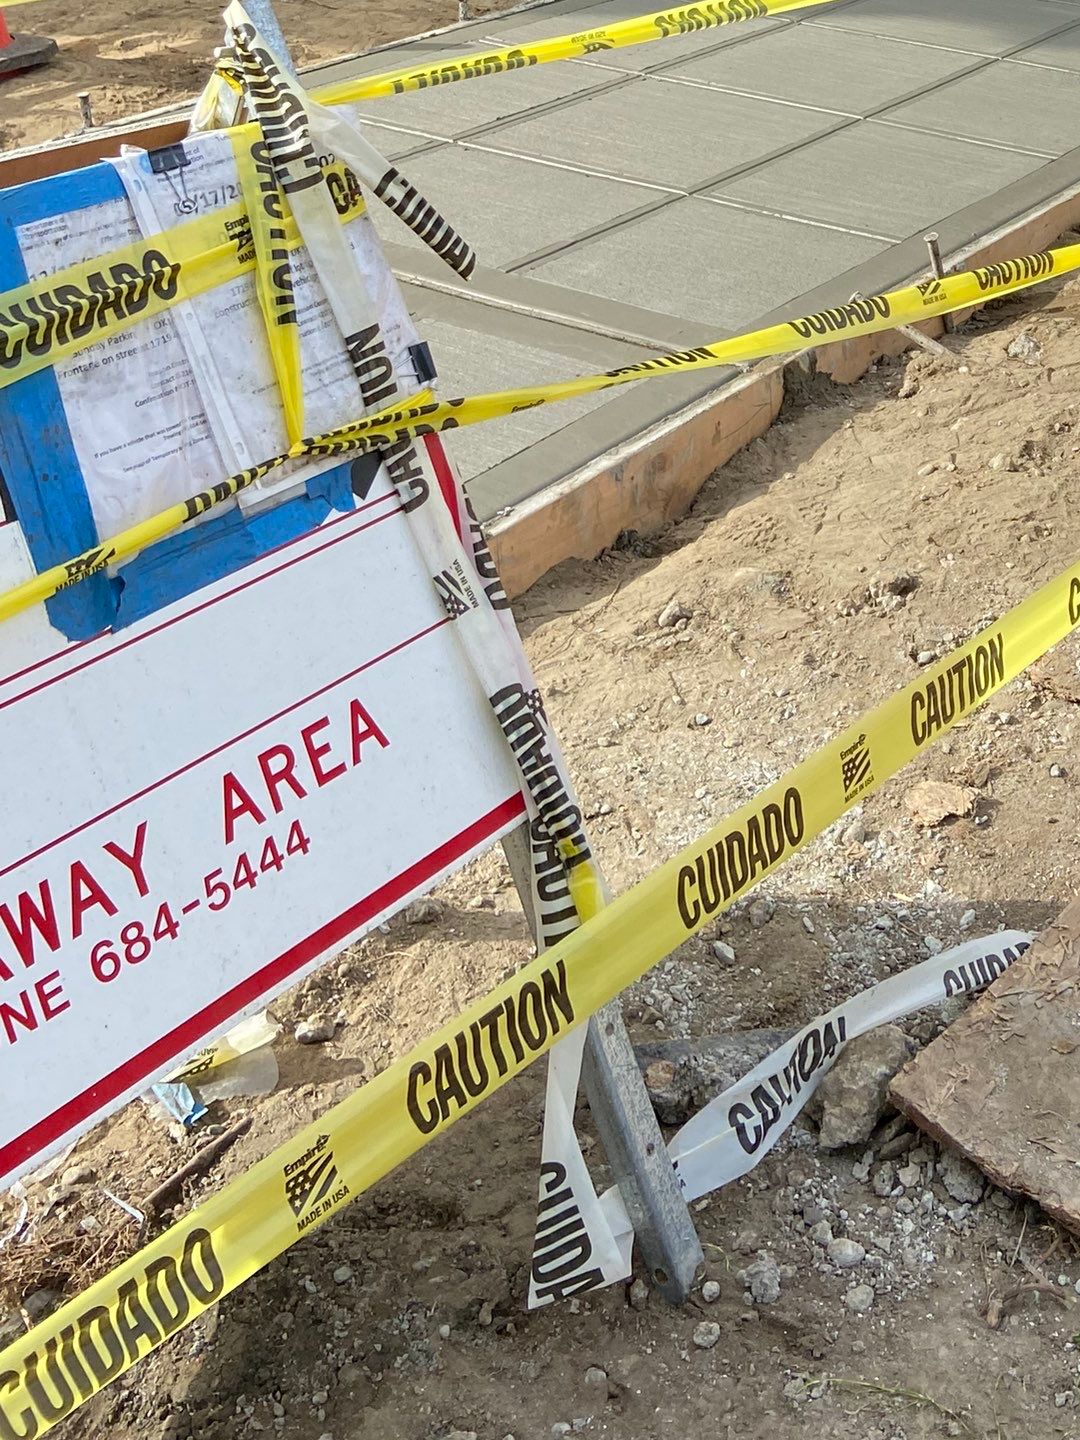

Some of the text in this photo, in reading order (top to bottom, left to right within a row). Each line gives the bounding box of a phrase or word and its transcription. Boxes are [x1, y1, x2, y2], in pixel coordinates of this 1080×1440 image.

[224, 214, 249, 232] Empi
[0, 249, 181, 369] CUIDADO
[107, 330, 136, 346] Parkin
[788, 296, 891, 338] CUIDADO
[973, 250, 1054, 290] CAUTION
[101, 353, 115, 366] on
[115, 345, 138, 361] stree
[346, 322, 430, 513] CAUION
[453, 559, 480, 608] MADE IN USA
[0, 697, 389, 981] WAY AREA
[90, 819, 312, 983] 684-5444
[0, 1226, 224, 1440] CUIDADO
[405, 959, 576, 1135] CAUTION
[676, 787, 804, 930] CUIDADO
[909, 633, 1005, 747] CAUTION
[283, 1138, 328, 1178] Empire
[296, 1185, 350, 1233] MADE IN USA
[529, 1160, 604, 1302] CUIDA
